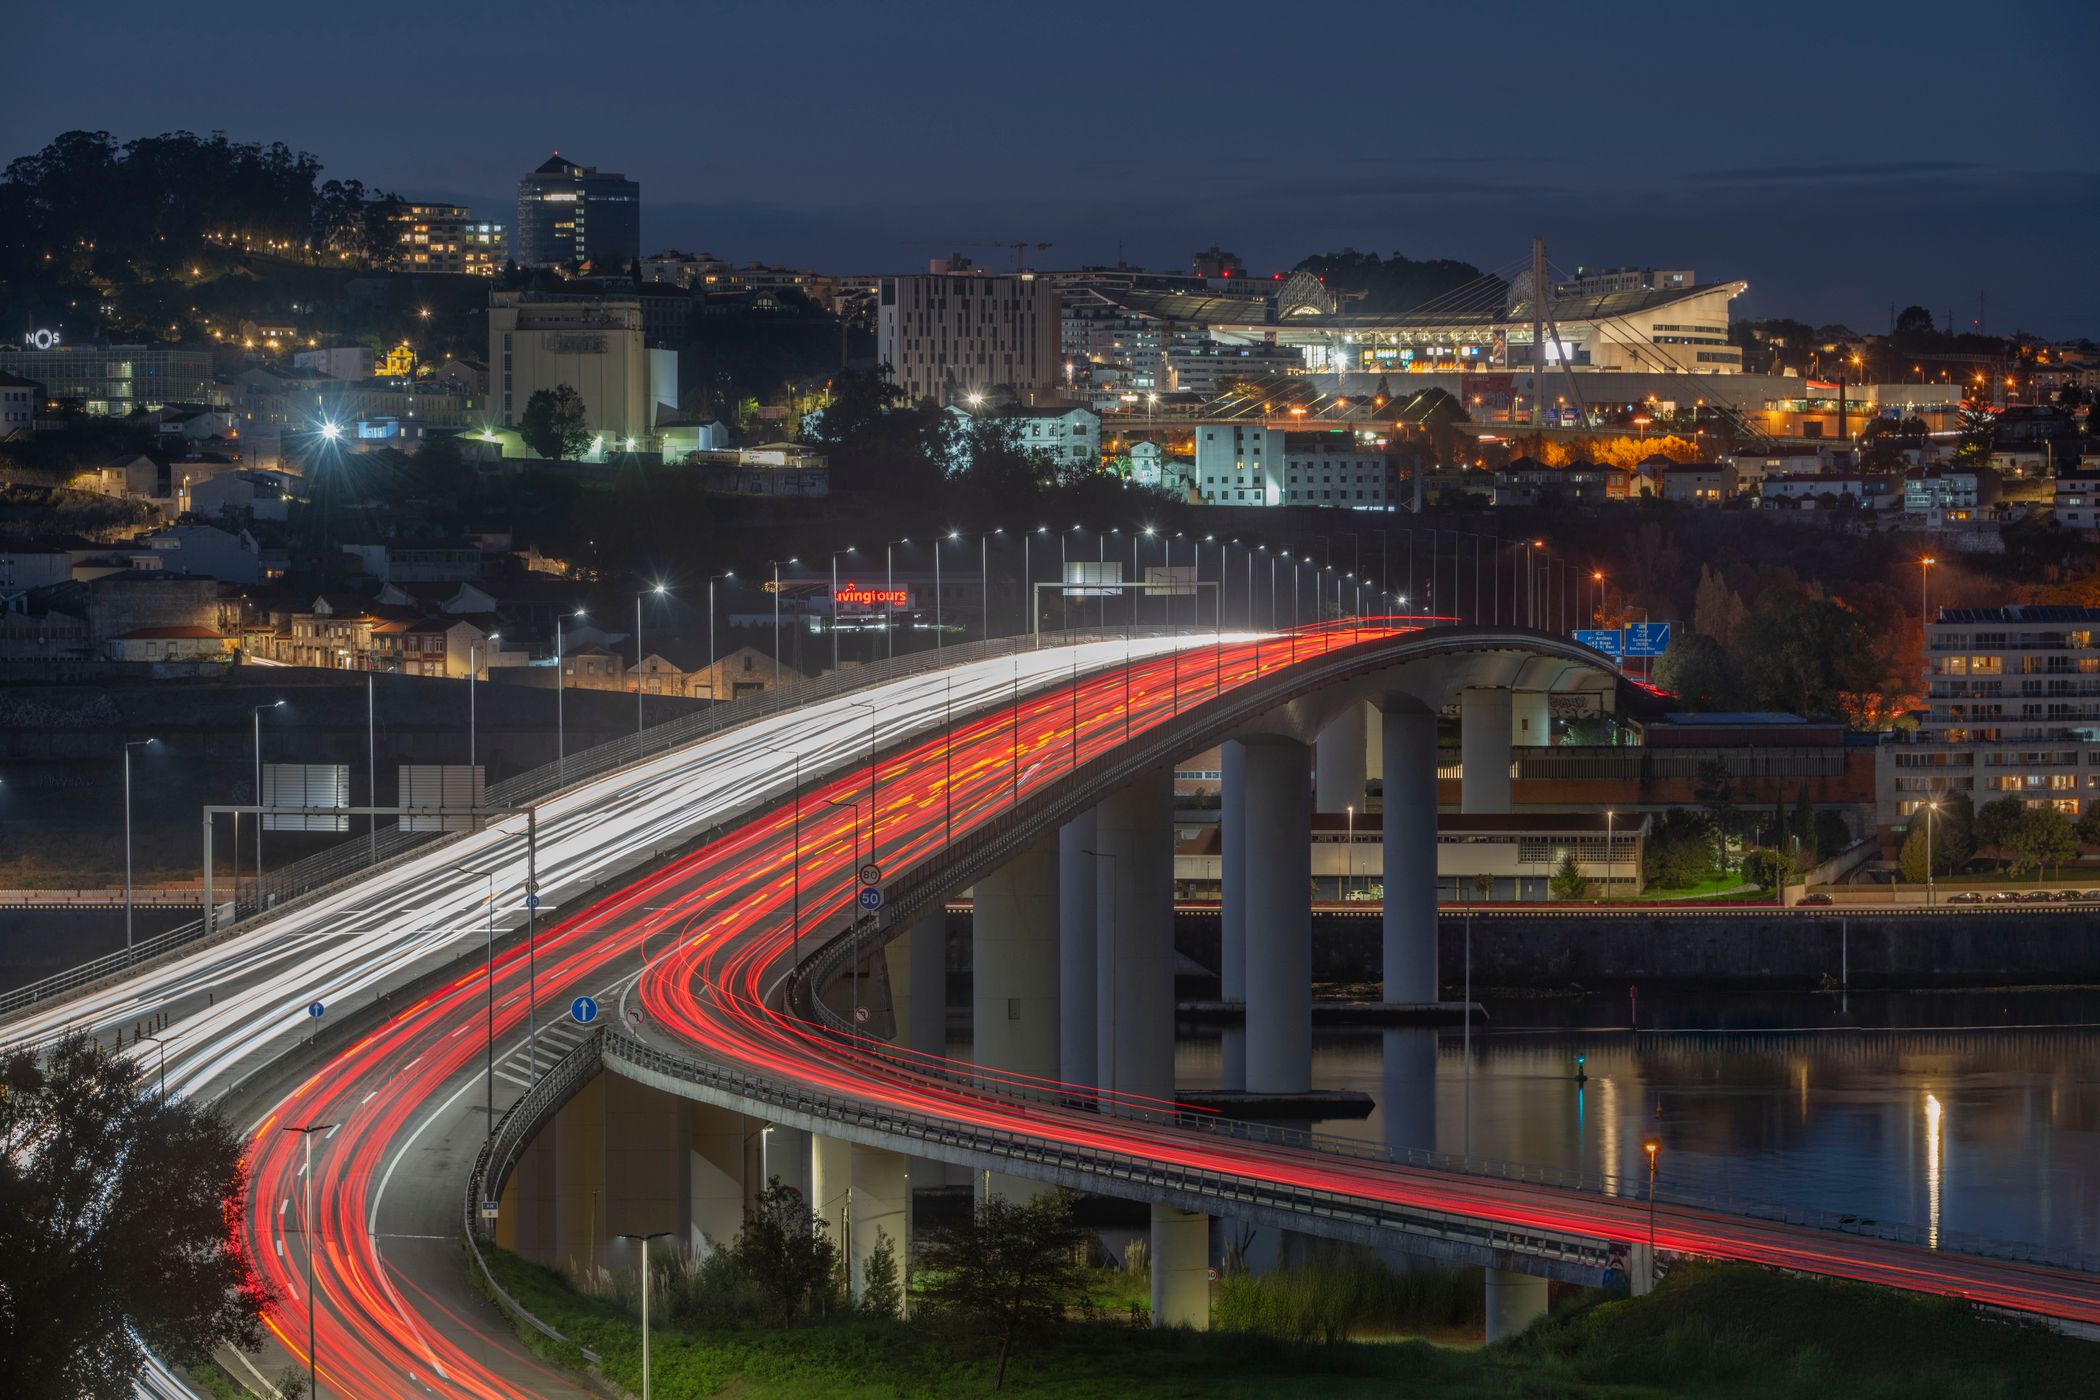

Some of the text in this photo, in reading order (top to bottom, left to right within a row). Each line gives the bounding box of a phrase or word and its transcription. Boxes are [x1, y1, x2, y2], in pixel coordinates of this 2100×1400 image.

[26, 329, 60, 349] NOS
[863, 870, 878, 880] 80
[862, 893, 879, 904] 50
